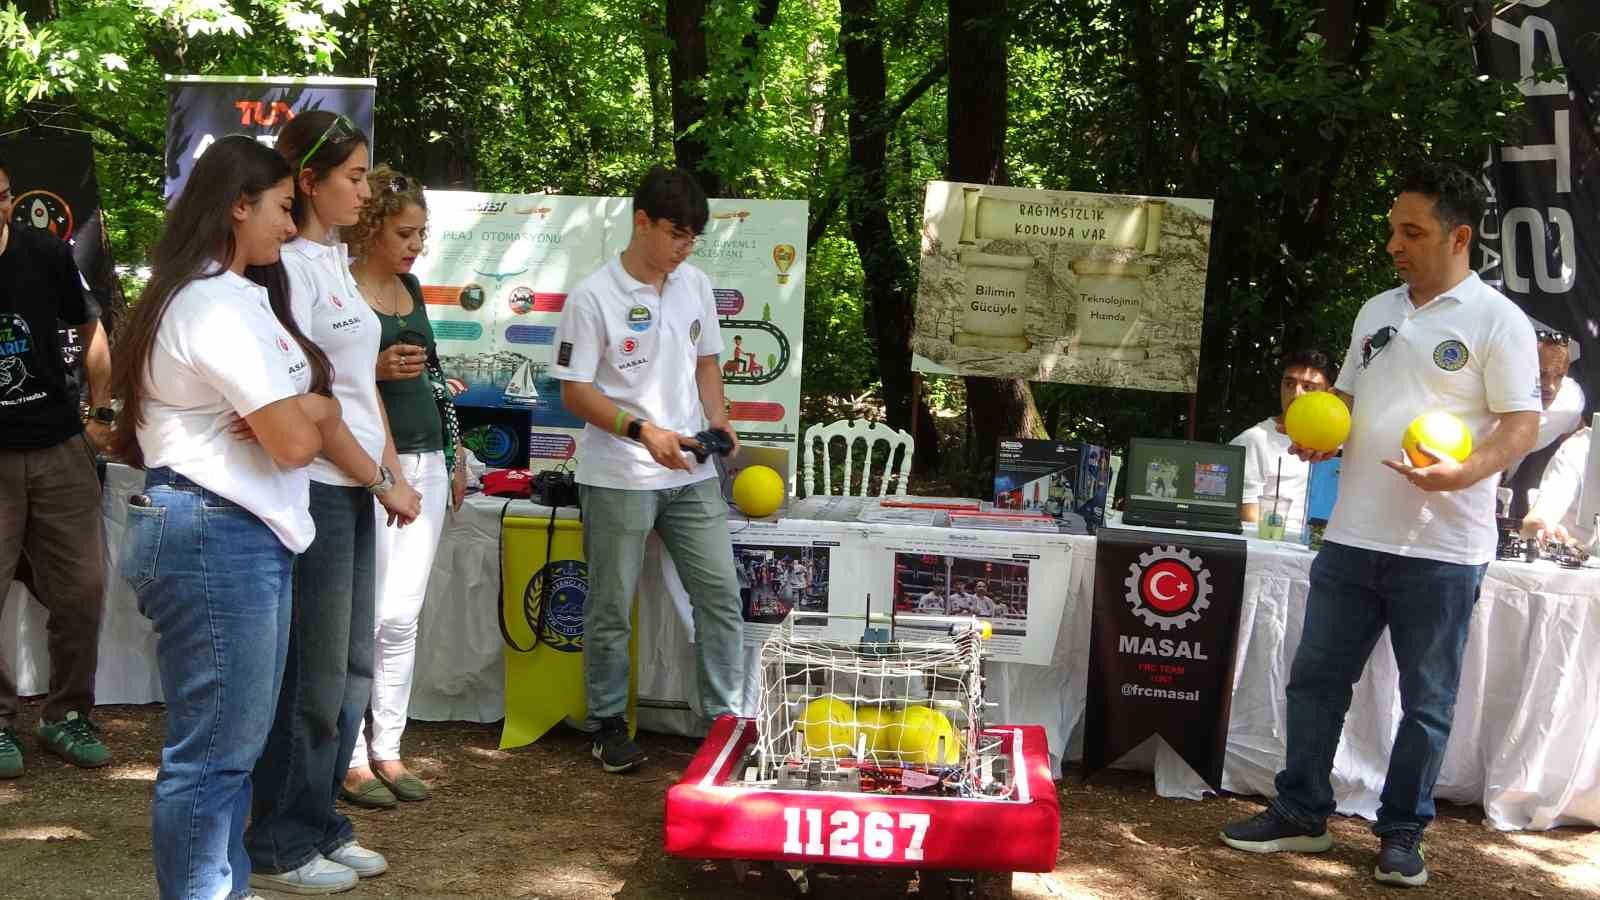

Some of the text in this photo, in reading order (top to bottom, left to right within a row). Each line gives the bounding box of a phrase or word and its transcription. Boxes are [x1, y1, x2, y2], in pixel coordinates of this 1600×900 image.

[1015, 223, 1107, 241] KODUNDA VAR
[975, 285, 1016, 298] Bilimin
[970, 301, 1017, 316] Gücüyle
[1118, 634, 1209, 661] MASAL
[1120, 682, 1201, 702] @frcmasal
[782, 806, 932, 862] 11267
